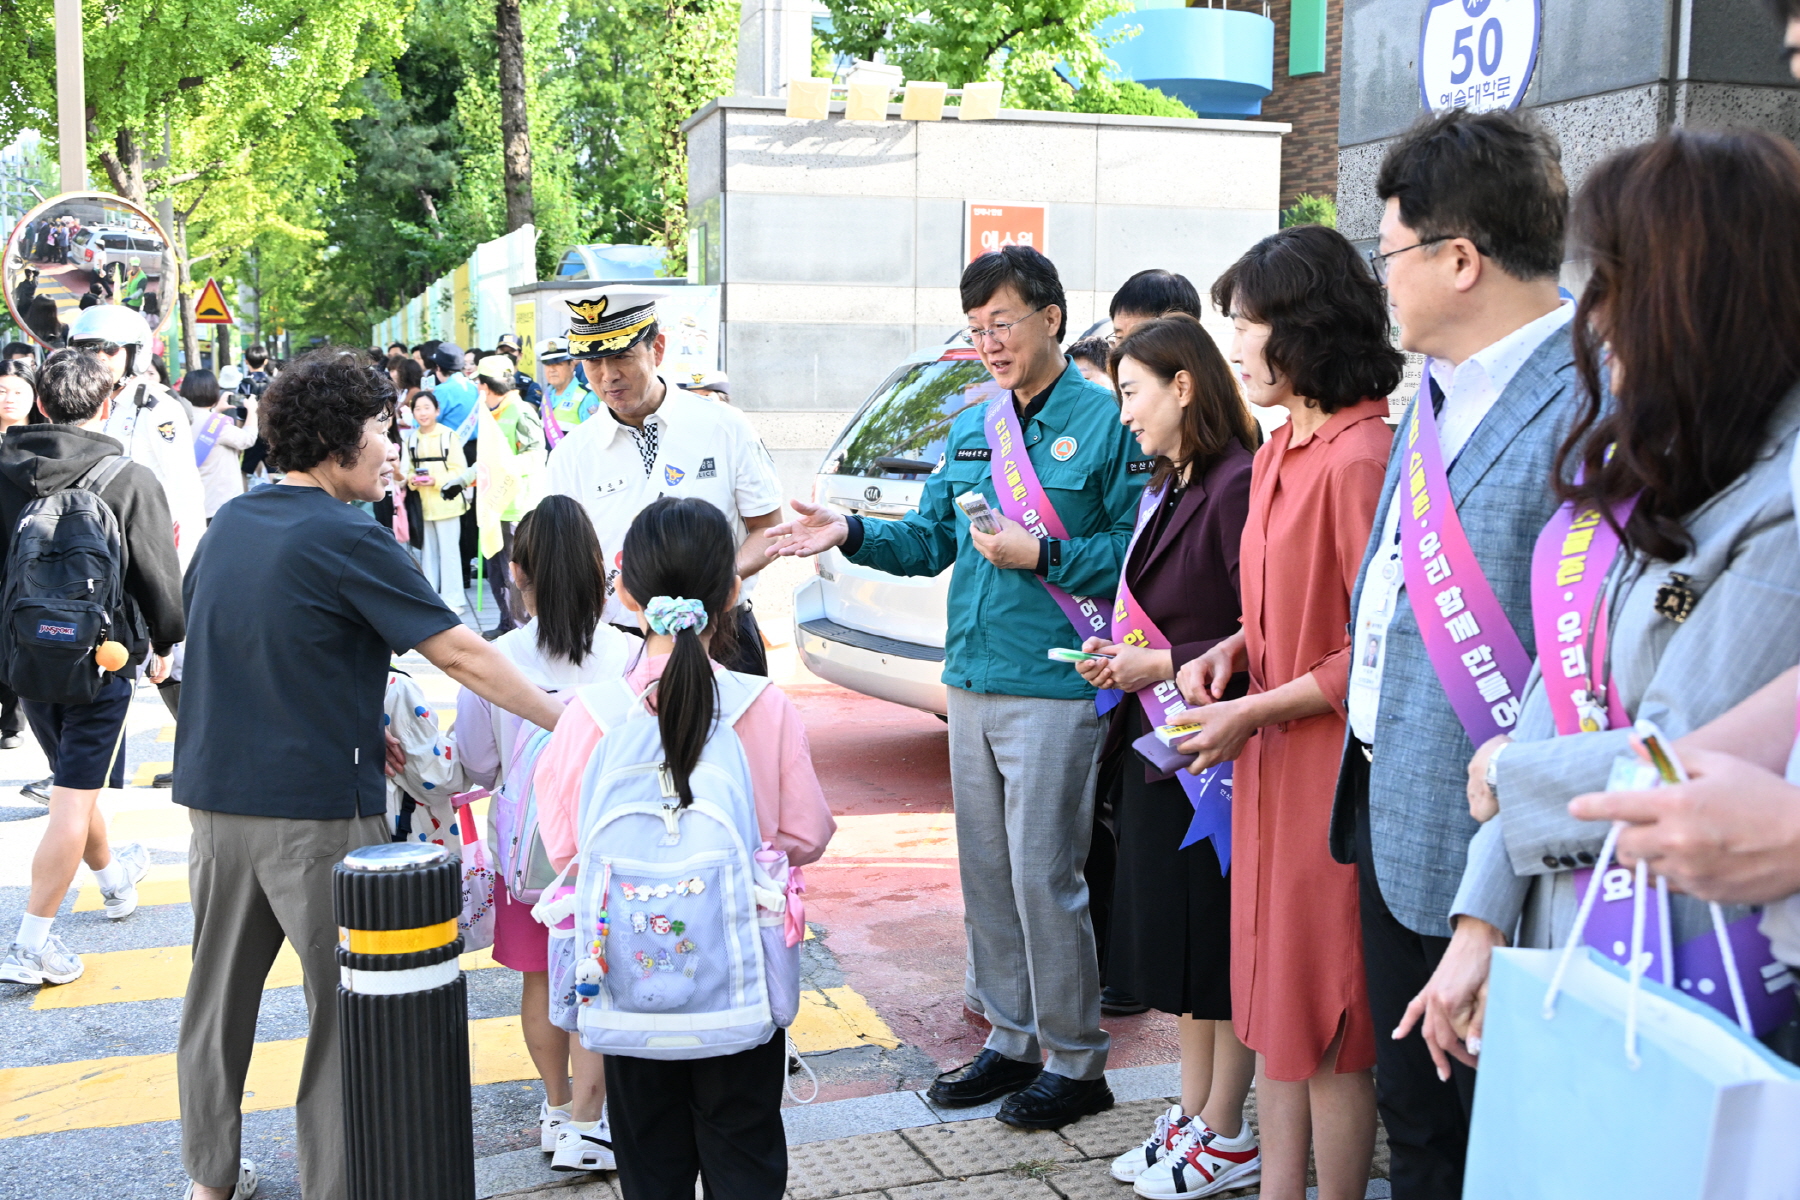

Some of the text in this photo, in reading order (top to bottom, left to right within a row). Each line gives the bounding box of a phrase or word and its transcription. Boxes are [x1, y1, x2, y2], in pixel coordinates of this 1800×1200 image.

[1450, 17, 1503, 85] 50
[1440, 76, 1511, 111] 예술대학로
[865, 488, 880, 500] KIA
[1418, 531, 1452, 587] 우리
[1434, 586, 1482, 643] 함께
[1557, 611, 1587, 678] 우리
